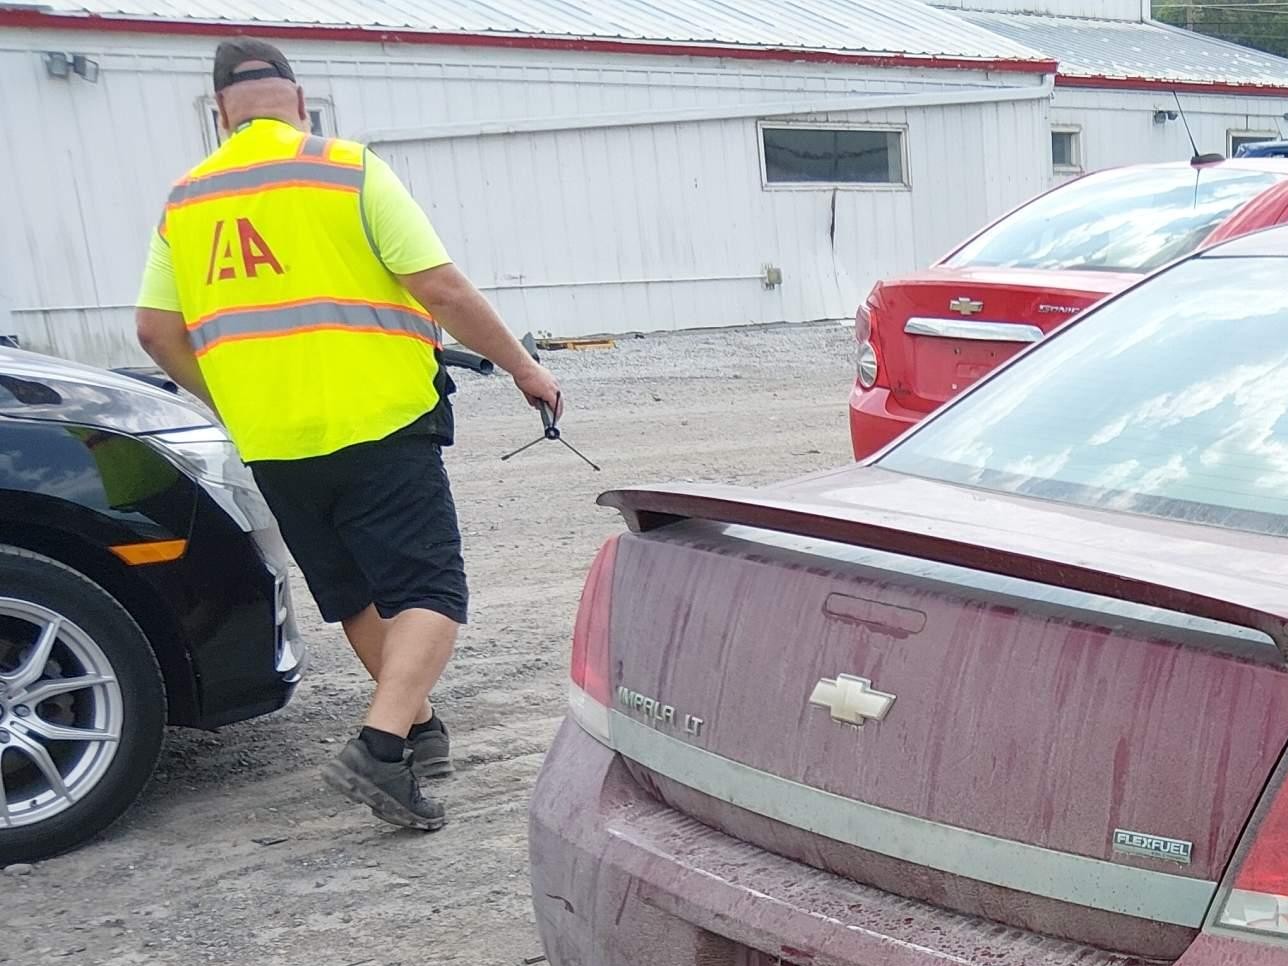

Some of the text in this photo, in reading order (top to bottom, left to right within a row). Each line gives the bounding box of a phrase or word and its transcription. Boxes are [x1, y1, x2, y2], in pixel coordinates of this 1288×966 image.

[617, 686, 704, 737] IMPALA LT
[1116, 833, 1188, 856] FLEXFUEL
